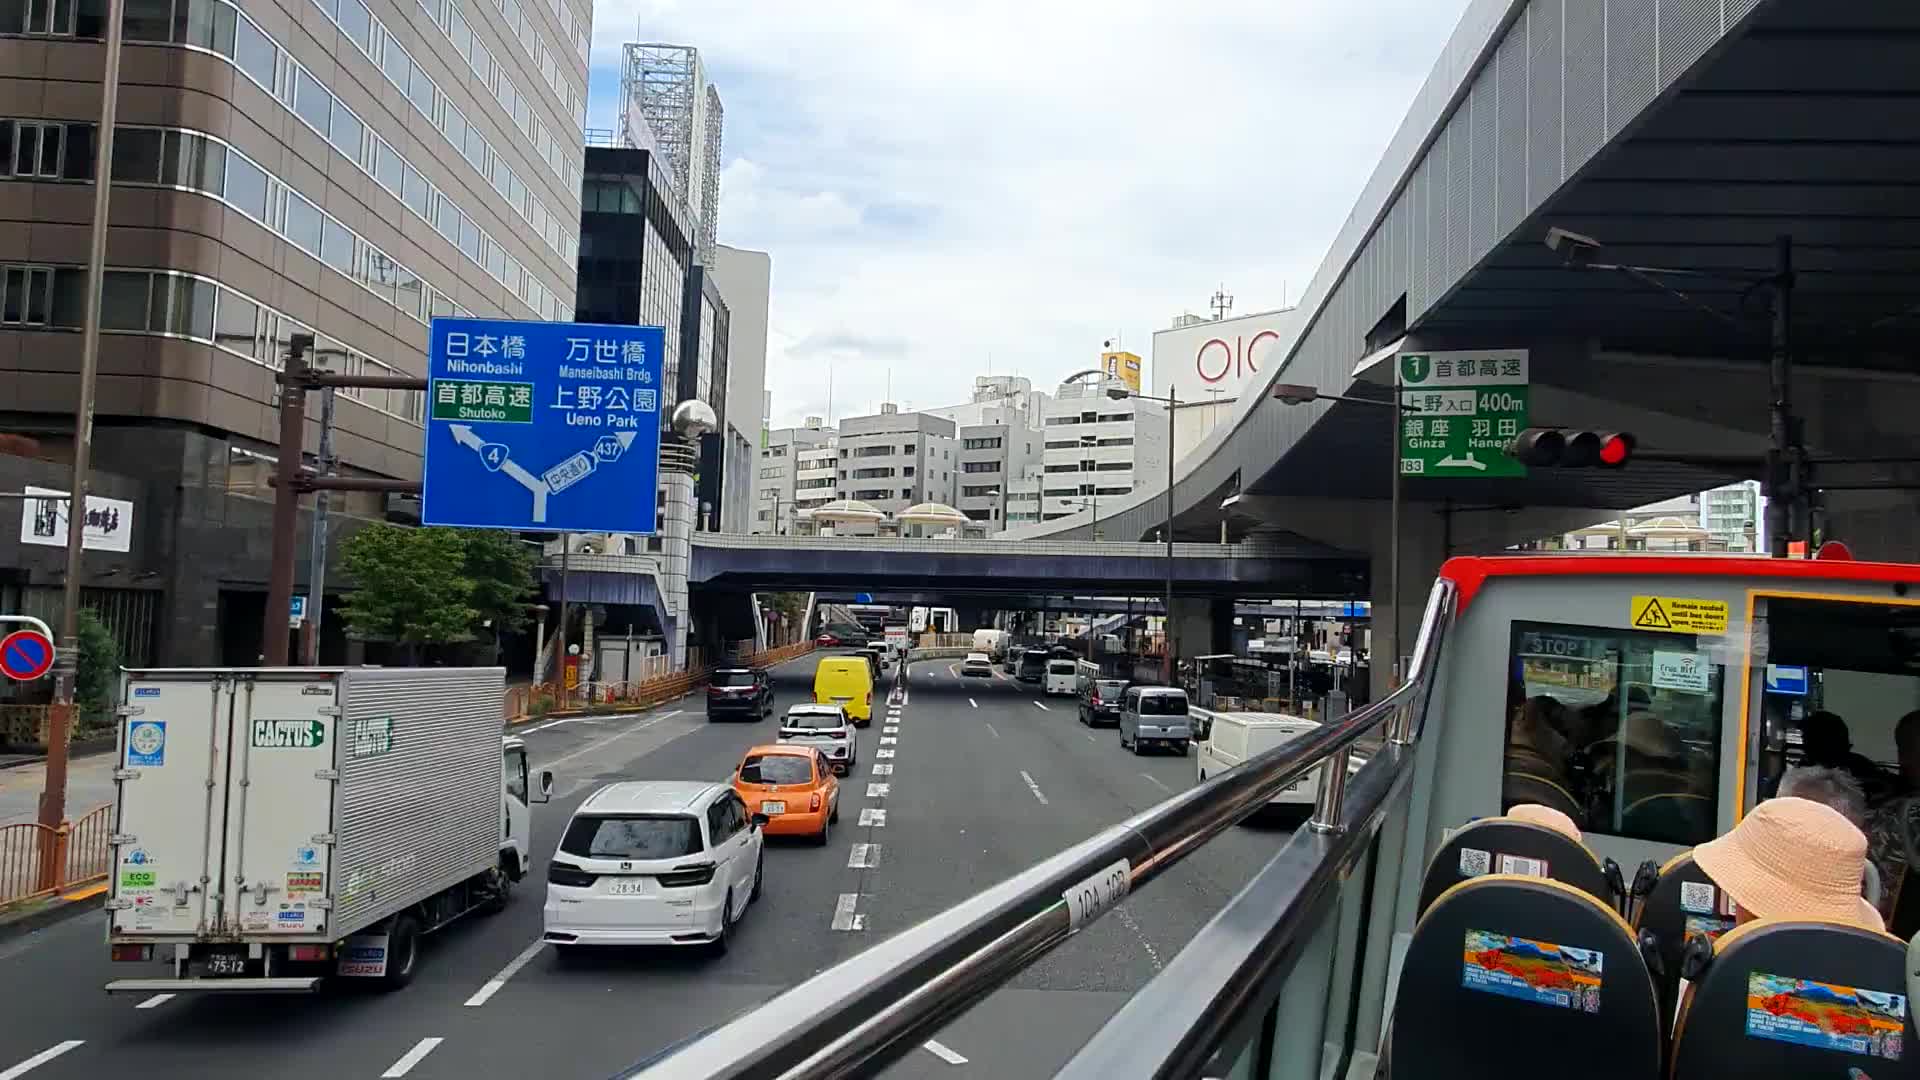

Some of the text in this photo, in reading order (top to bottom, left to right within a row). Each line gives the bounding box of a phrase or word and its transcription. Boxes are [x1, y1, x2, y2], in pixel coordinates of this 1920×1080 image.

[447, 332, 526, 359] 日本橋
[566, 338, 646, 364] 万世橋
[447, 360, 522, 375] Nihonbashi
[559, 365, 652, 384] Manseibashi Brdg.
[1410, 357, 1419, 376] 1
[1435, 359, 1520, 377] 首都高速
[437, 383, 531, 407] 首都高速
[550, 384, 657, 412] 上野公園
[1479, 393, 1523, 412] 400m
[459, 406, 506, 419] Shutoko
[566, 412, 638, 428] Ueno Park
[1405, 419, 1516, 437] 銀座 羽田
[597, 442, 618, 456] 437
[1409, 438, 1518, 448] Ginza Haned
[488, 447, 499, 463] 4
[550, 457, 588, 485] 中央通り
[255, 720, 314, 746] CACTUS
